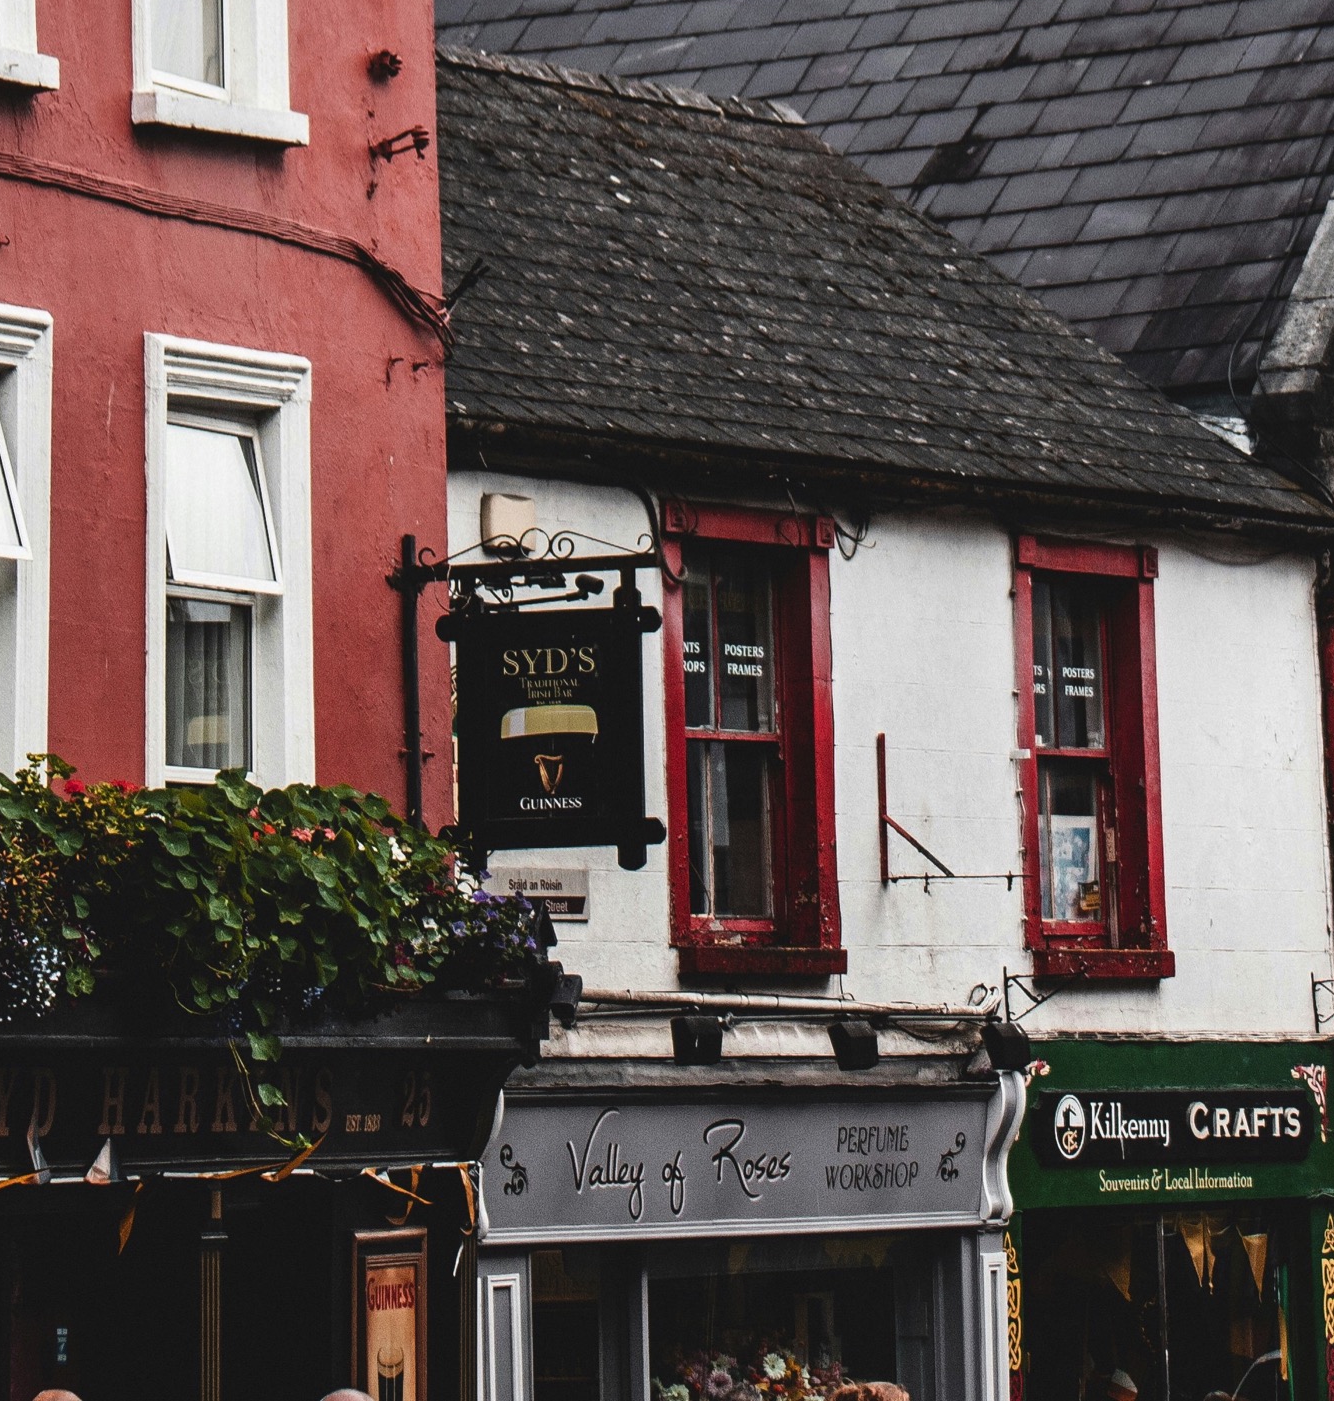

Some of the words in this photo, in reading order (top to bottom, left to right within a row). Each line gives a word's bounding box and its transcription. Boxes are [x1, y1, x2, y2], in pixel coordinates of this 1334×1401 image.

[503, 647, 595, 676] SYD'S
[724, 643, 764, 659] POSTERS
[727, 662, 763, 677] FRAMES
[1062, 666, 1095, 680] POSTERS
[1064, 685, 1094, 698] FRAMES
[520, 797, 582, 811] GUINNESS
[529, 881, 539, 890] an
[545, 899, 569, 913] Street
[401, 1070, 432, 1128] 25
[1090, 1101, 1170, 1147] Kilkenny
[836, 1124, 910, 1154] PERFUME
[567, 1107, 645, 1222] Valley
[661, 1150, 684, 1218] of
[703, 1118, 792, 1200] Roses
[825, 1160, 920, 1192] WORKSHOP
[1099, 1169, 1150, 1192] Souvenirs
[1151, 1168, 1163, 1191] &
[1165, 1167, 1193, 1190] Local
[1195, 1166, 1253, 1189] Information
[367, 1277, 415, 1312] GUINNESS
